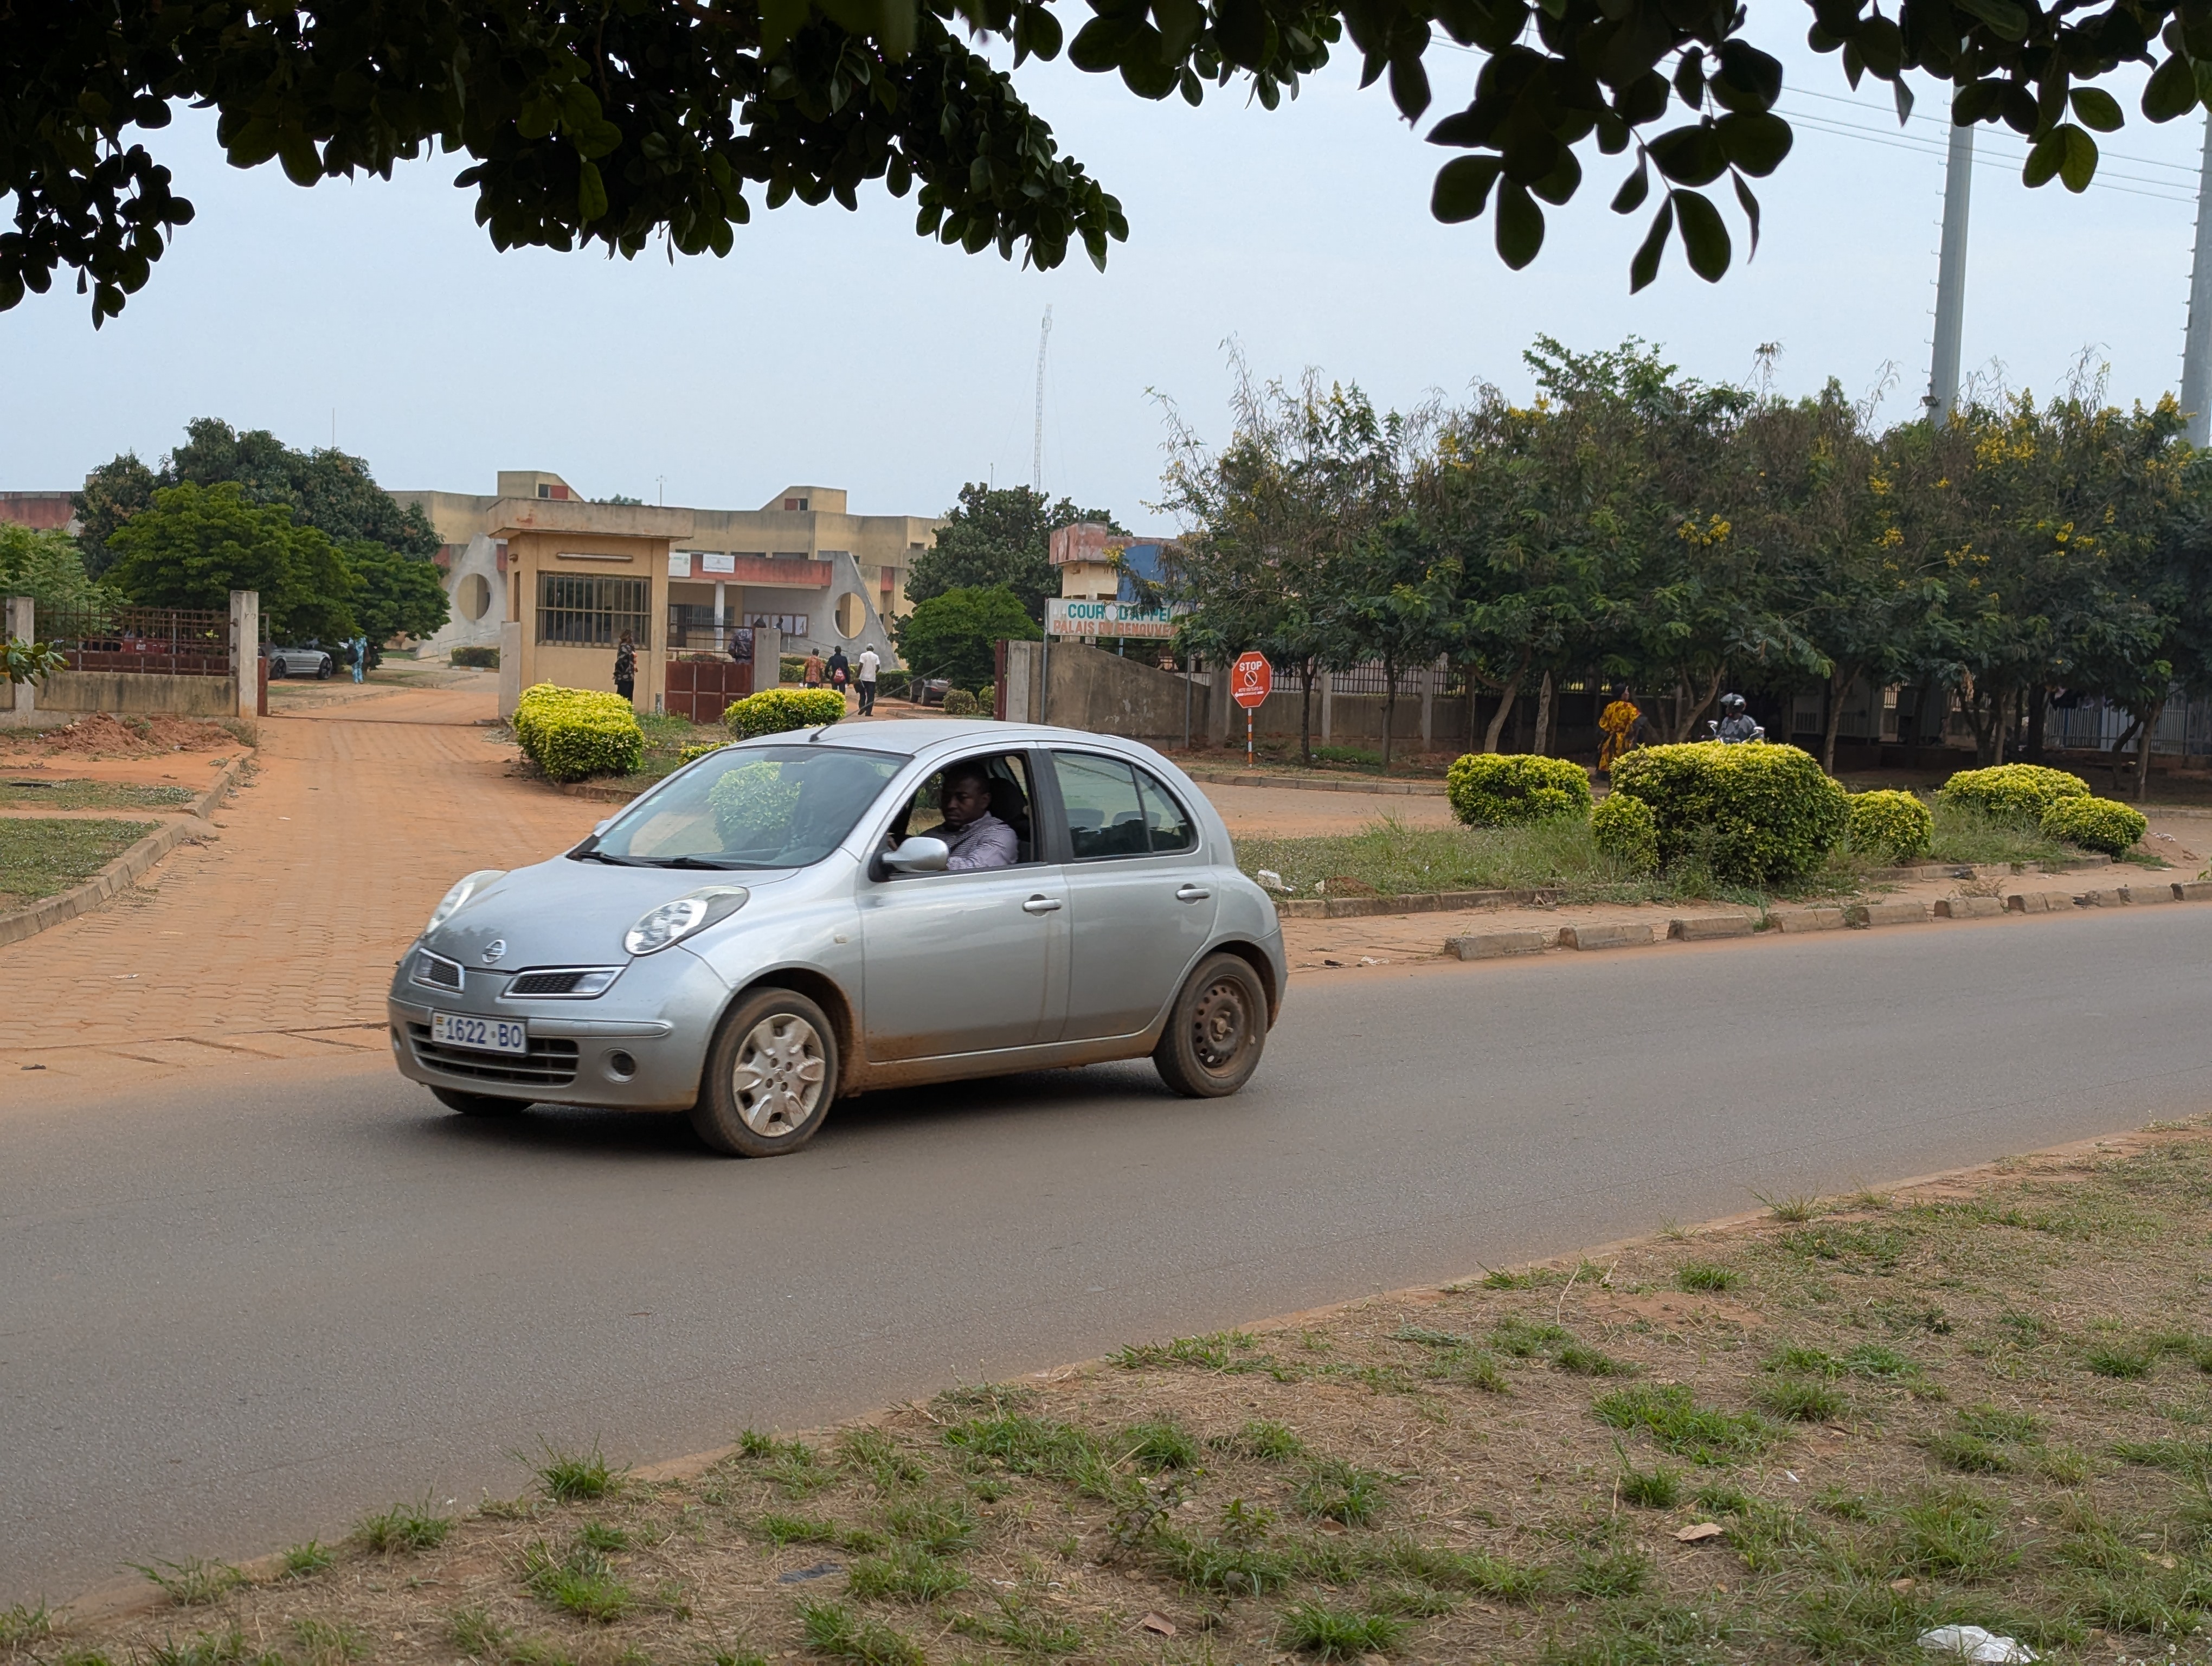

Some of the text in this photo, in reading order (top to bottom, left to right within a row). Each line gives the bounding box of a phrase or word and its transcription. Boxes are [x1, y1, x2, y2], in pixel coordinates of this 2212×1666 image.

[1068, 604, 1172, 623] COUR DAPPEL
[1053, 620, 1095, 635] PALAIS
[1239, 661, 1262, 671] STOP
[447, 1017, 487, 1045] 1622
